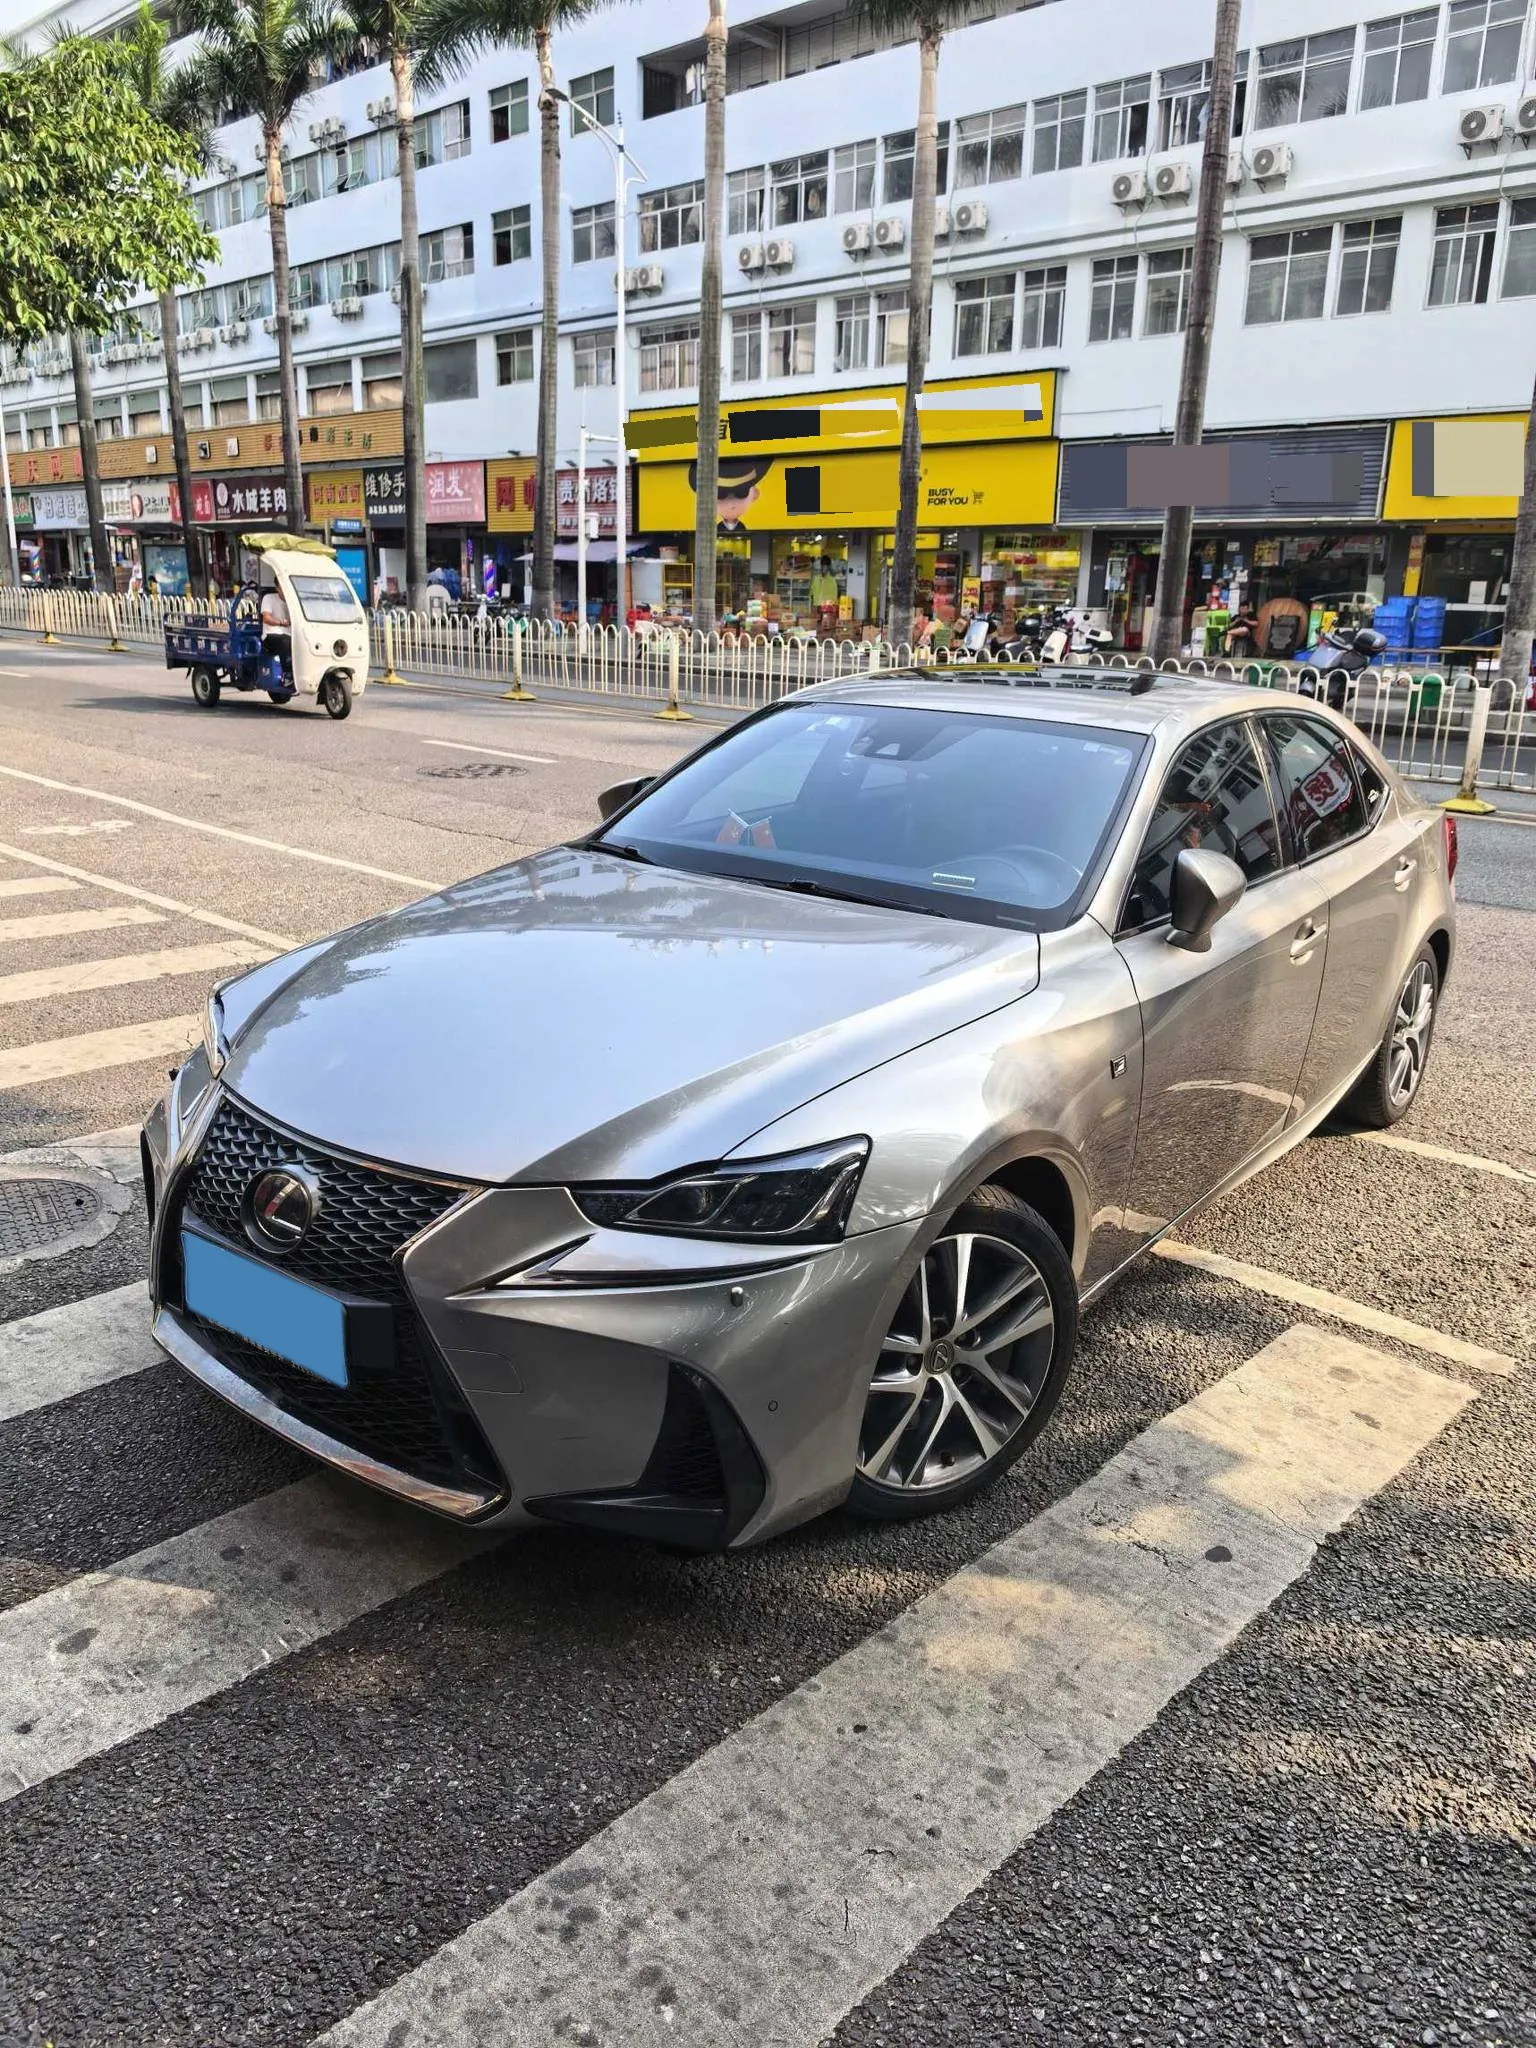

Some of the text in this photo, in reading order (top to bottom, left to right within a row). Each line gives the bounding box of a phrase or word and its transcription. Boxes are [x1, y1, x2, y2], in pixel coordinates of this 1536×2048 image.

[365, 471, 406, 498] 维修手
[428, 465, 465, 498] 润发
[928, 488, 955, 497] BUSY
[232, 486, 287, 514] 水城羊肉
[927, 497, 969, 506] FOR YOU
